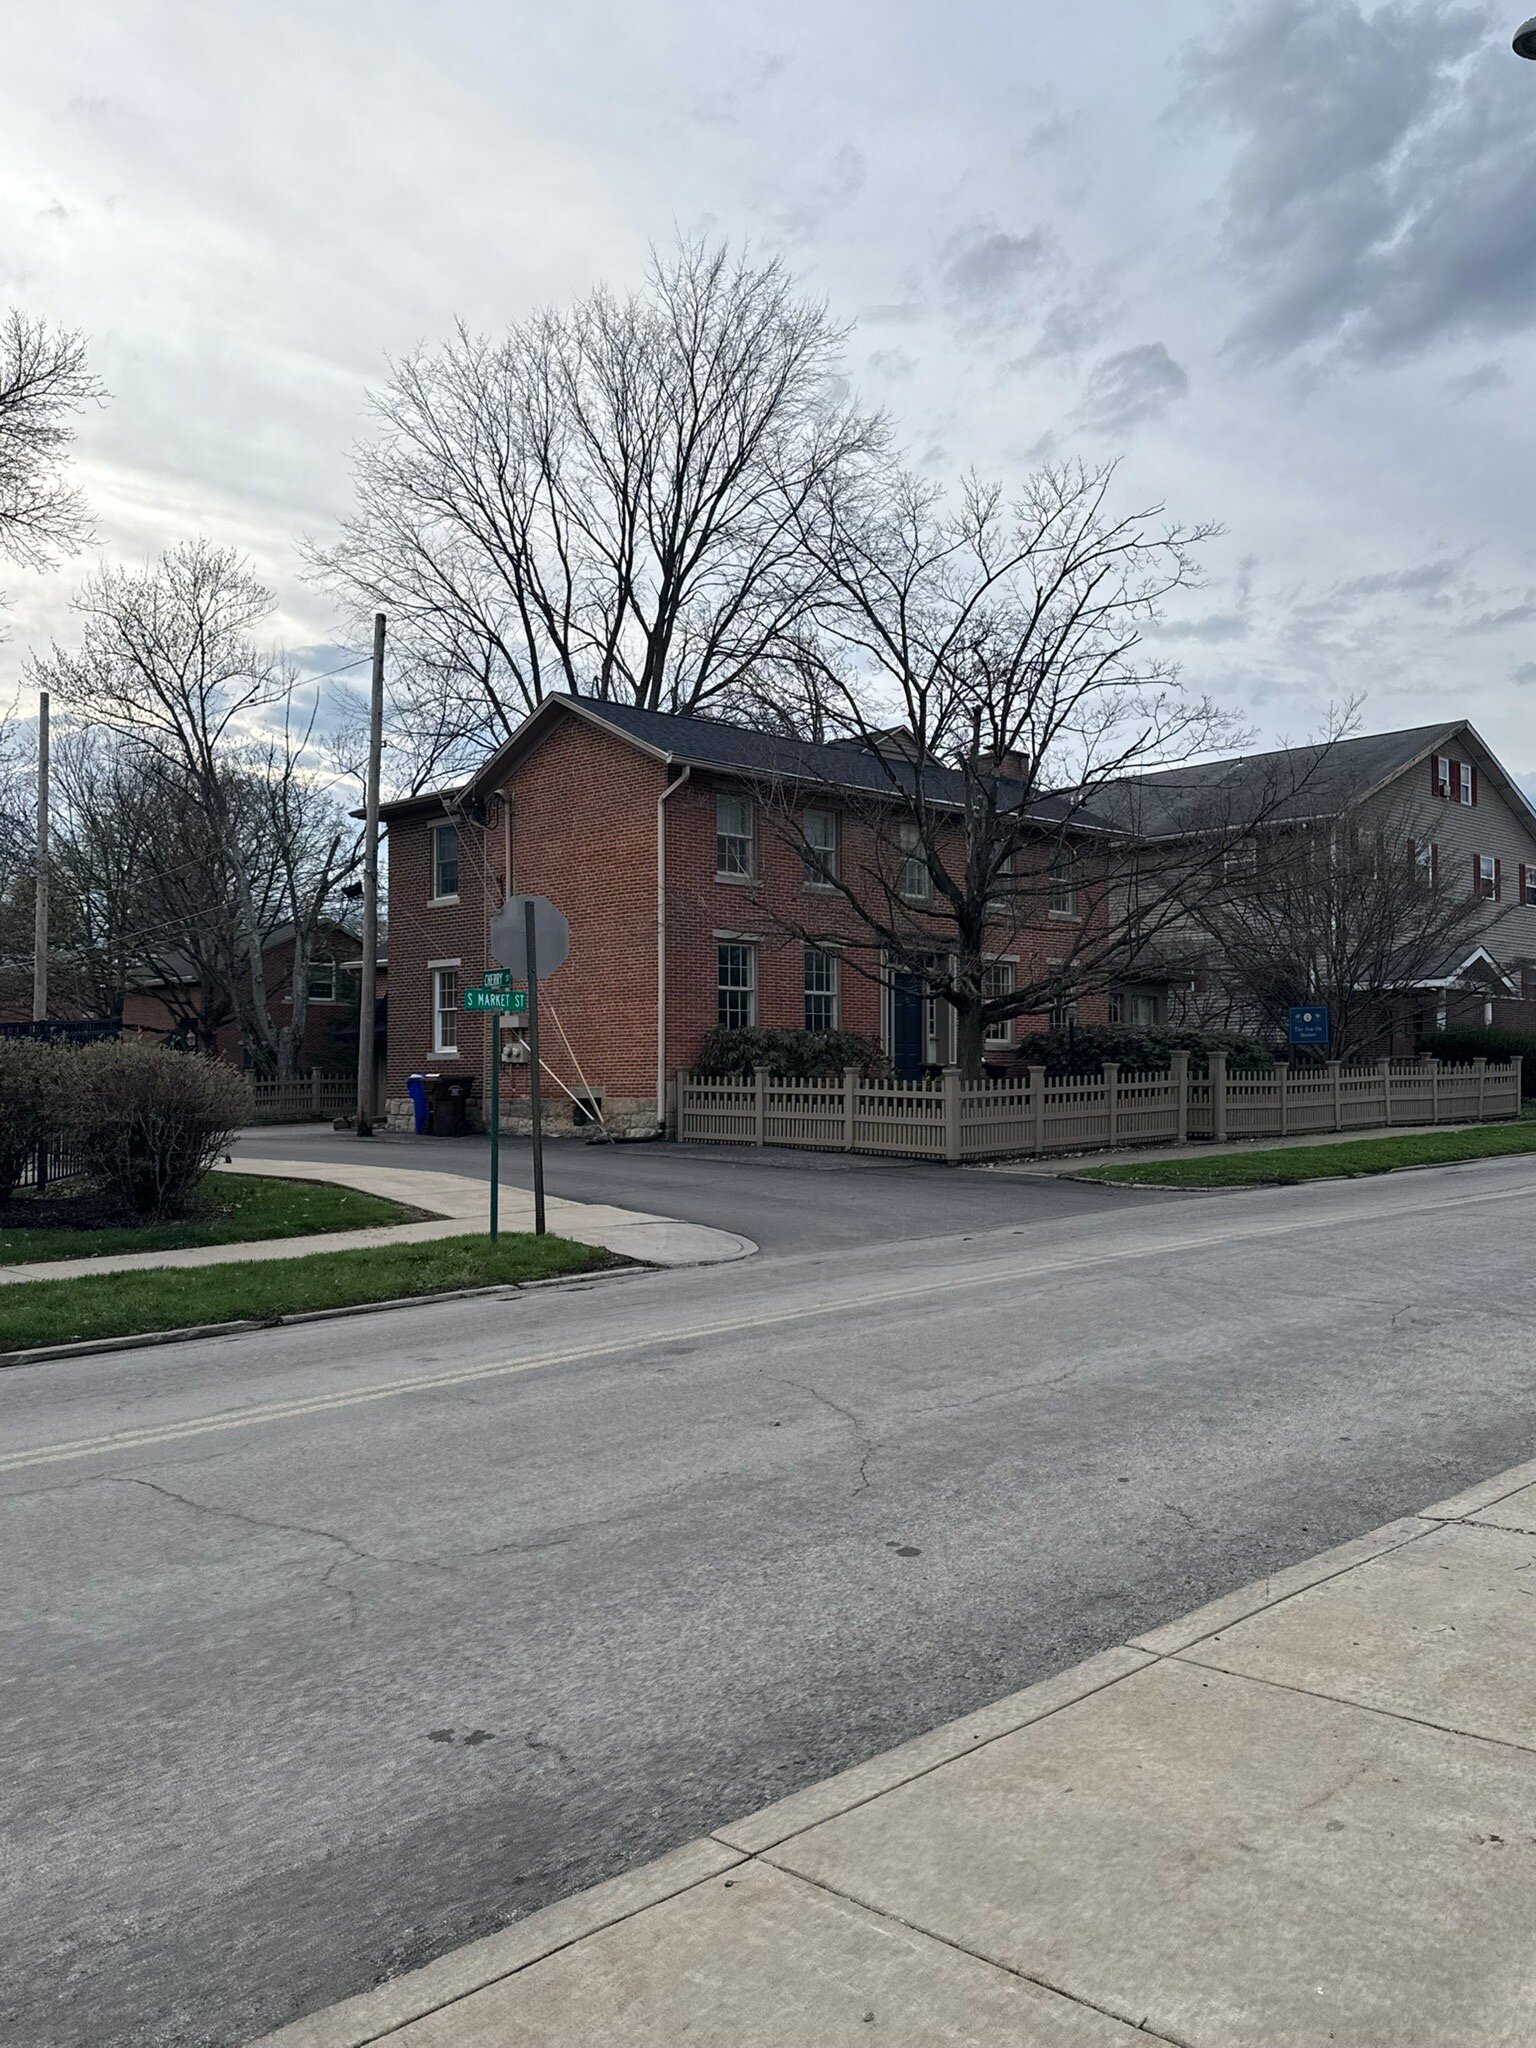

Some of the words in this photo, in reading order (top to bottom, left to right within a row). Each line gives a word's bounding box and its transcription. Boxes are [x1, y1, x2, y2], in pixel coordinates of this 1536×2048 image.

[484, 972, 503, 987] CHERRY
[467, 992, 473, 1006] S
[477, 993, 510, 1007] MARKET
[514, 994, 525, 1008] ST
